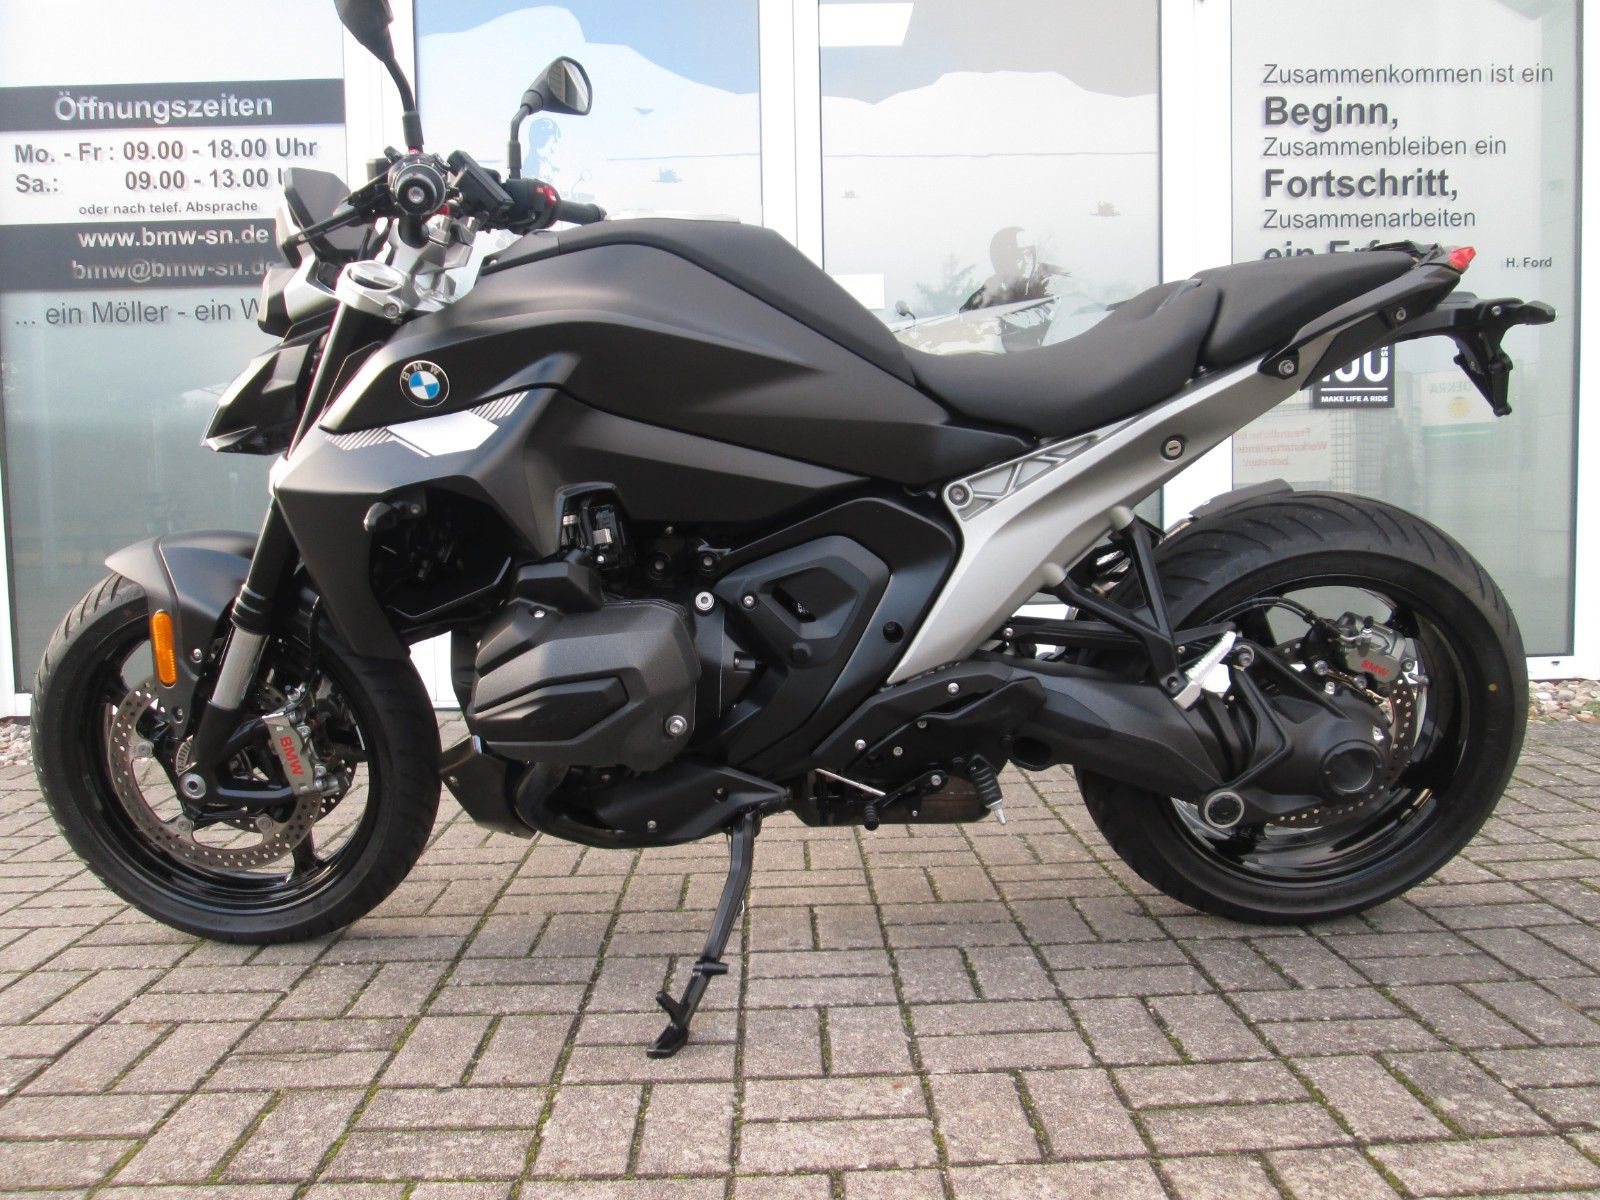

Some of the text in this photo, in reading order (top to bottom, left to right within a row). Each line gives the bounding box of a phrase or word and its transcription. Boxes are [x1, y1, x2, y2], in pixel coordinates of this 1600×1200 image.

[1262, 63, 1553, 84] Zusammenkommen ist ein
[54, 91, 273, 125] Öffnungszeiten
[1264, 95, 1399, 132] Beginn,
[14, 143, 55, 163] Mo.
[123, 140, 184, 161] 09.00
[207, 138, 267, 159] 18.00
[276, 137, 318, 158] Uhr
[1262, 135, 1507, 157] Zusammenbleiben ein
[15, 173, 59, 193] Sa.:
[125, 170, 185, 190] 09.00
[208, 168, 269, 189] 13.00
[1264, 168, 1458, 201] Fortschritt,
[79, 200, 258, 215] oder nach telef. Absprache
[1262, 207, 1476, 229] Zusammenarbeiten
[77, 224, 270, 248] www.bmw-sn.de
[1505, 256, 1553, 268] H. Ford
[45, 302, 83, 325] ein
[92, 299, 169, 324] Möller
[195, 299, 232, 321] ein
[402, 362, 441, 381] BMW
[1321, 395, 1345, 403] MAKE
[280, 735, 305, 776] BMW
